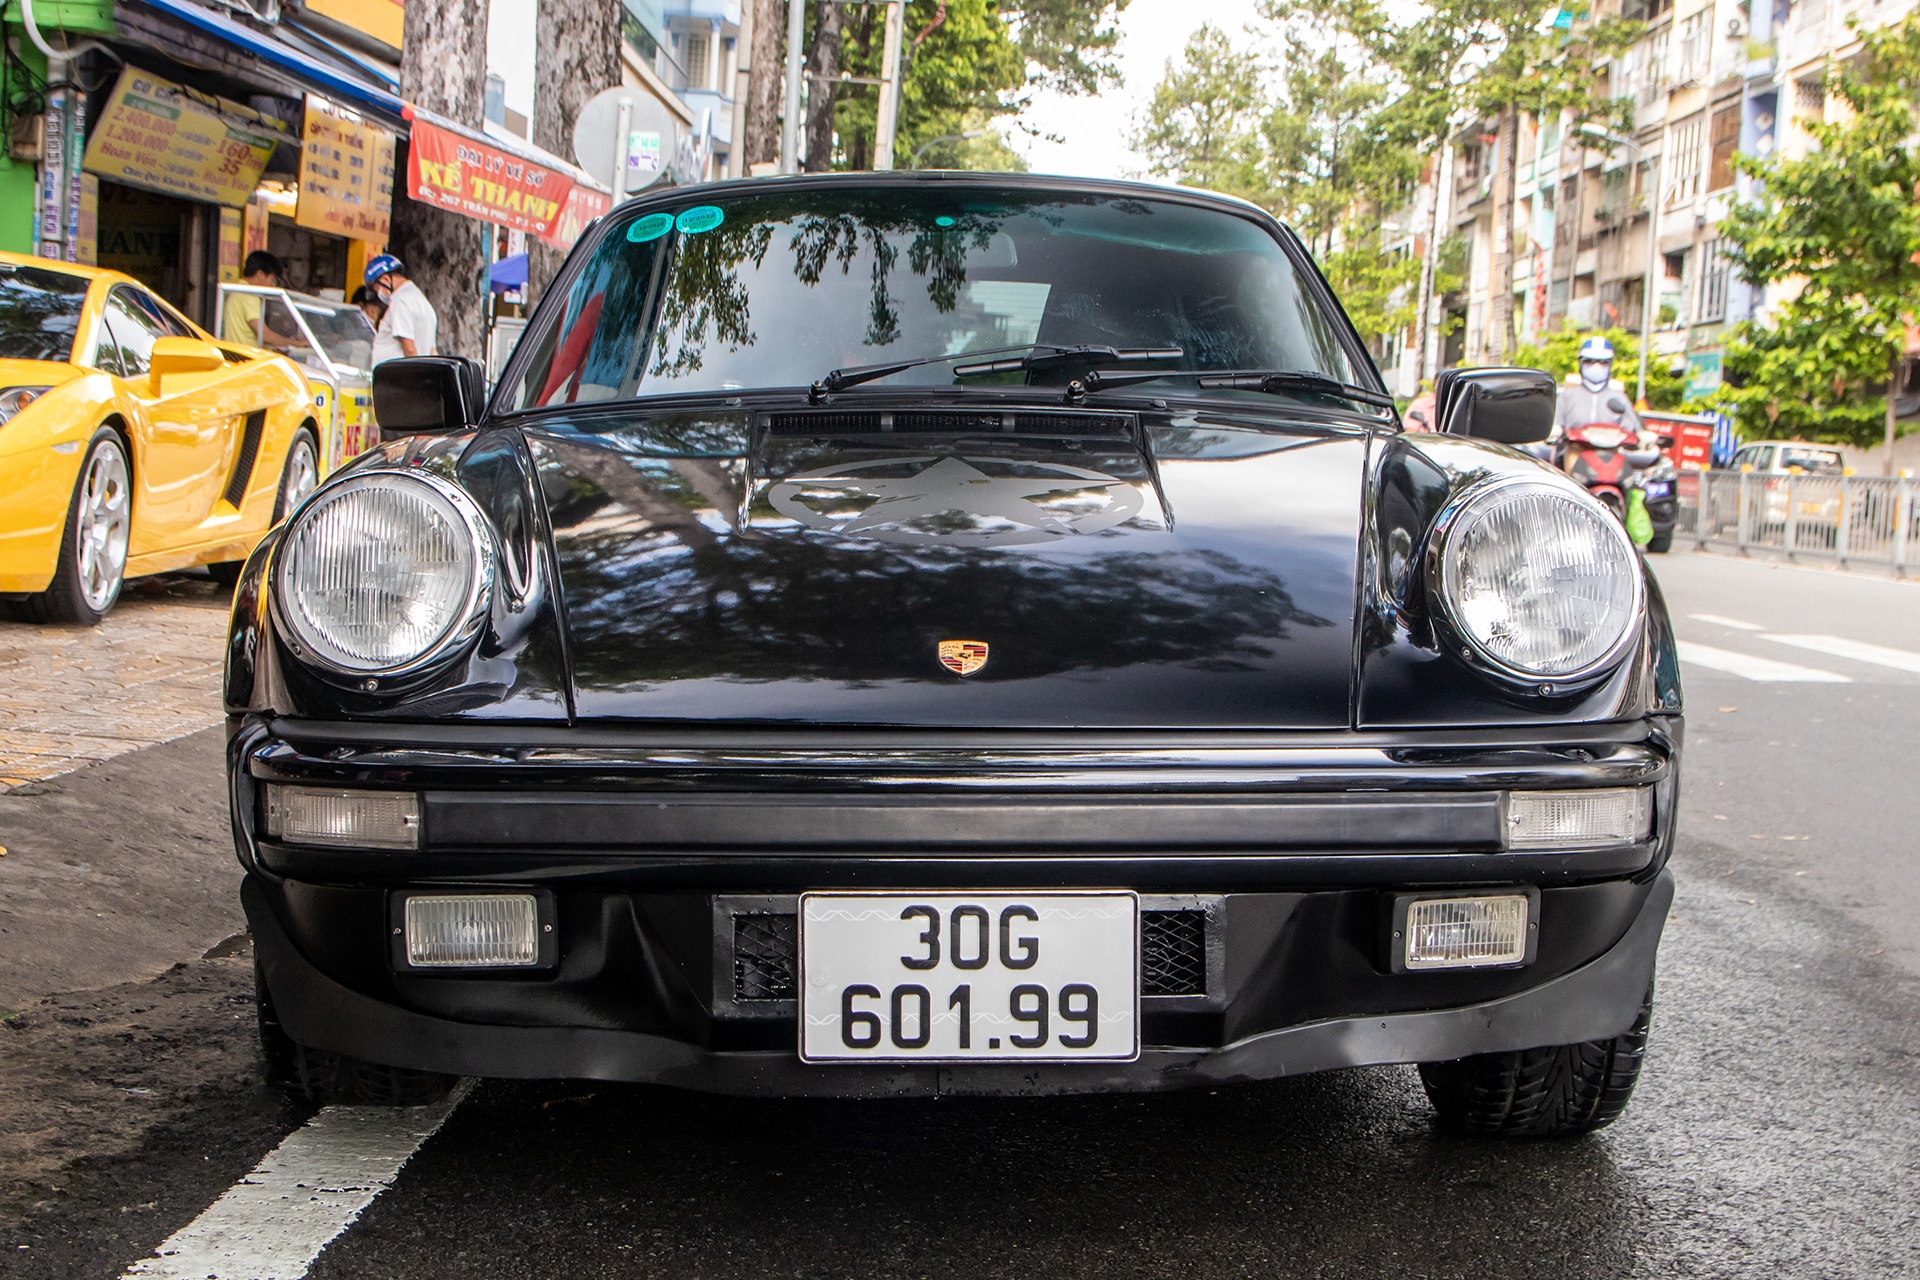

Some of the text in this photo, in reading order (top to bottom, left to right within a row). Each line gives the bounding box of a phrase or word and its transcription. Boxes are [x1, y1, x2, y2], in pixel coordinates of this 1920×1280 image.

[420, 157, 462, 194] KẾ
[470, 175, 559, 223] THANH
[457, 143, 548, 189] ĐẠI LÝ VÉ SỐ
[685, 213, 717, 223] 12/2022
[901, 904, 1039, 970] 30G
[842, 983, 1098, 1049] 601.99
